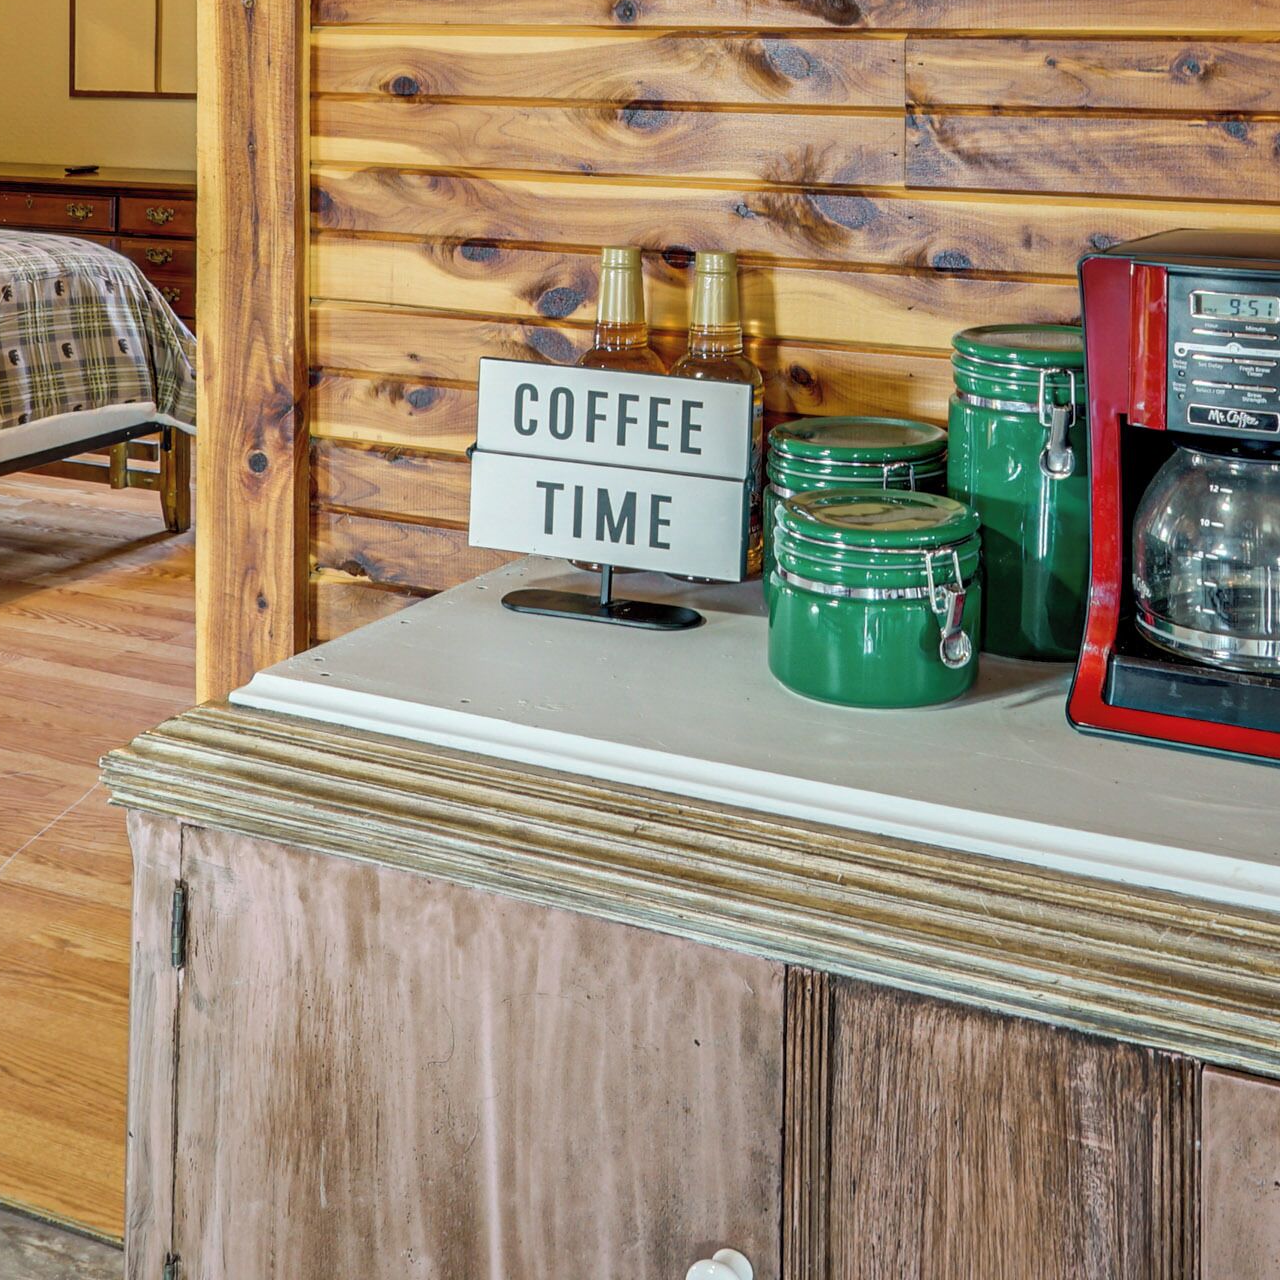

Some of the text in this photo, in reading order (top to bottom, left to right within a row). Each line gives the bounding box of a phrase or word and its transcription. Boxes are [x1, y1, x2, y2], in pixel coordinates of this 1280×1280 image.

[1230, 298, 1273, 317] 9:51
[1245, 325, 1266, 333] Minute
[513, 382, 704, 455] COFFEE
[1209, 484, 1219, 493] 12
[536, 480, 673, 550] TIME
[1200, 518, 1210, 527] 10
[1195, 605, 1201, 613] 4
